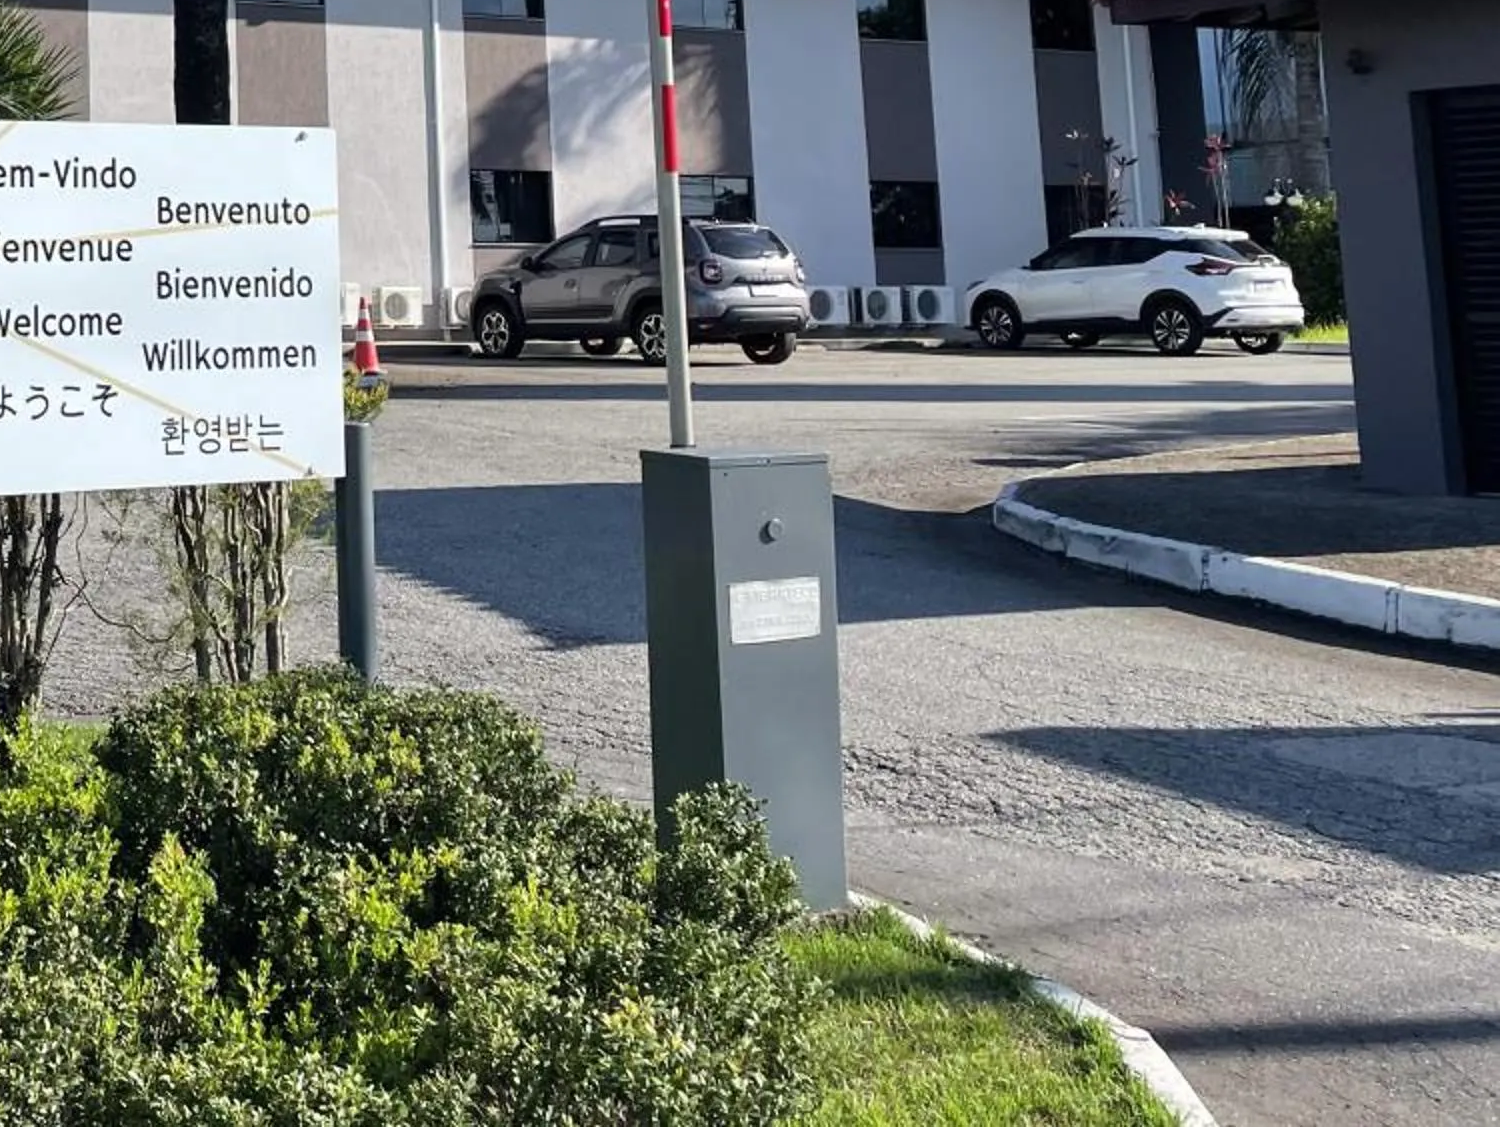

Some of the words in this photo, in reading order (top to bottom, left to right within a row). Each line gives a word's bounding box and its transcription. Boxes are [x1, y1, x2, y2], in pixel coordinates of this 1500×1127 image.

[158, 196, 311, 226] Benvenuto
[157, 267, 313, 300] Bienvenido
[142, 338, 317, 372] Willkommen
[162, 414, 285, 456] 환영받는
